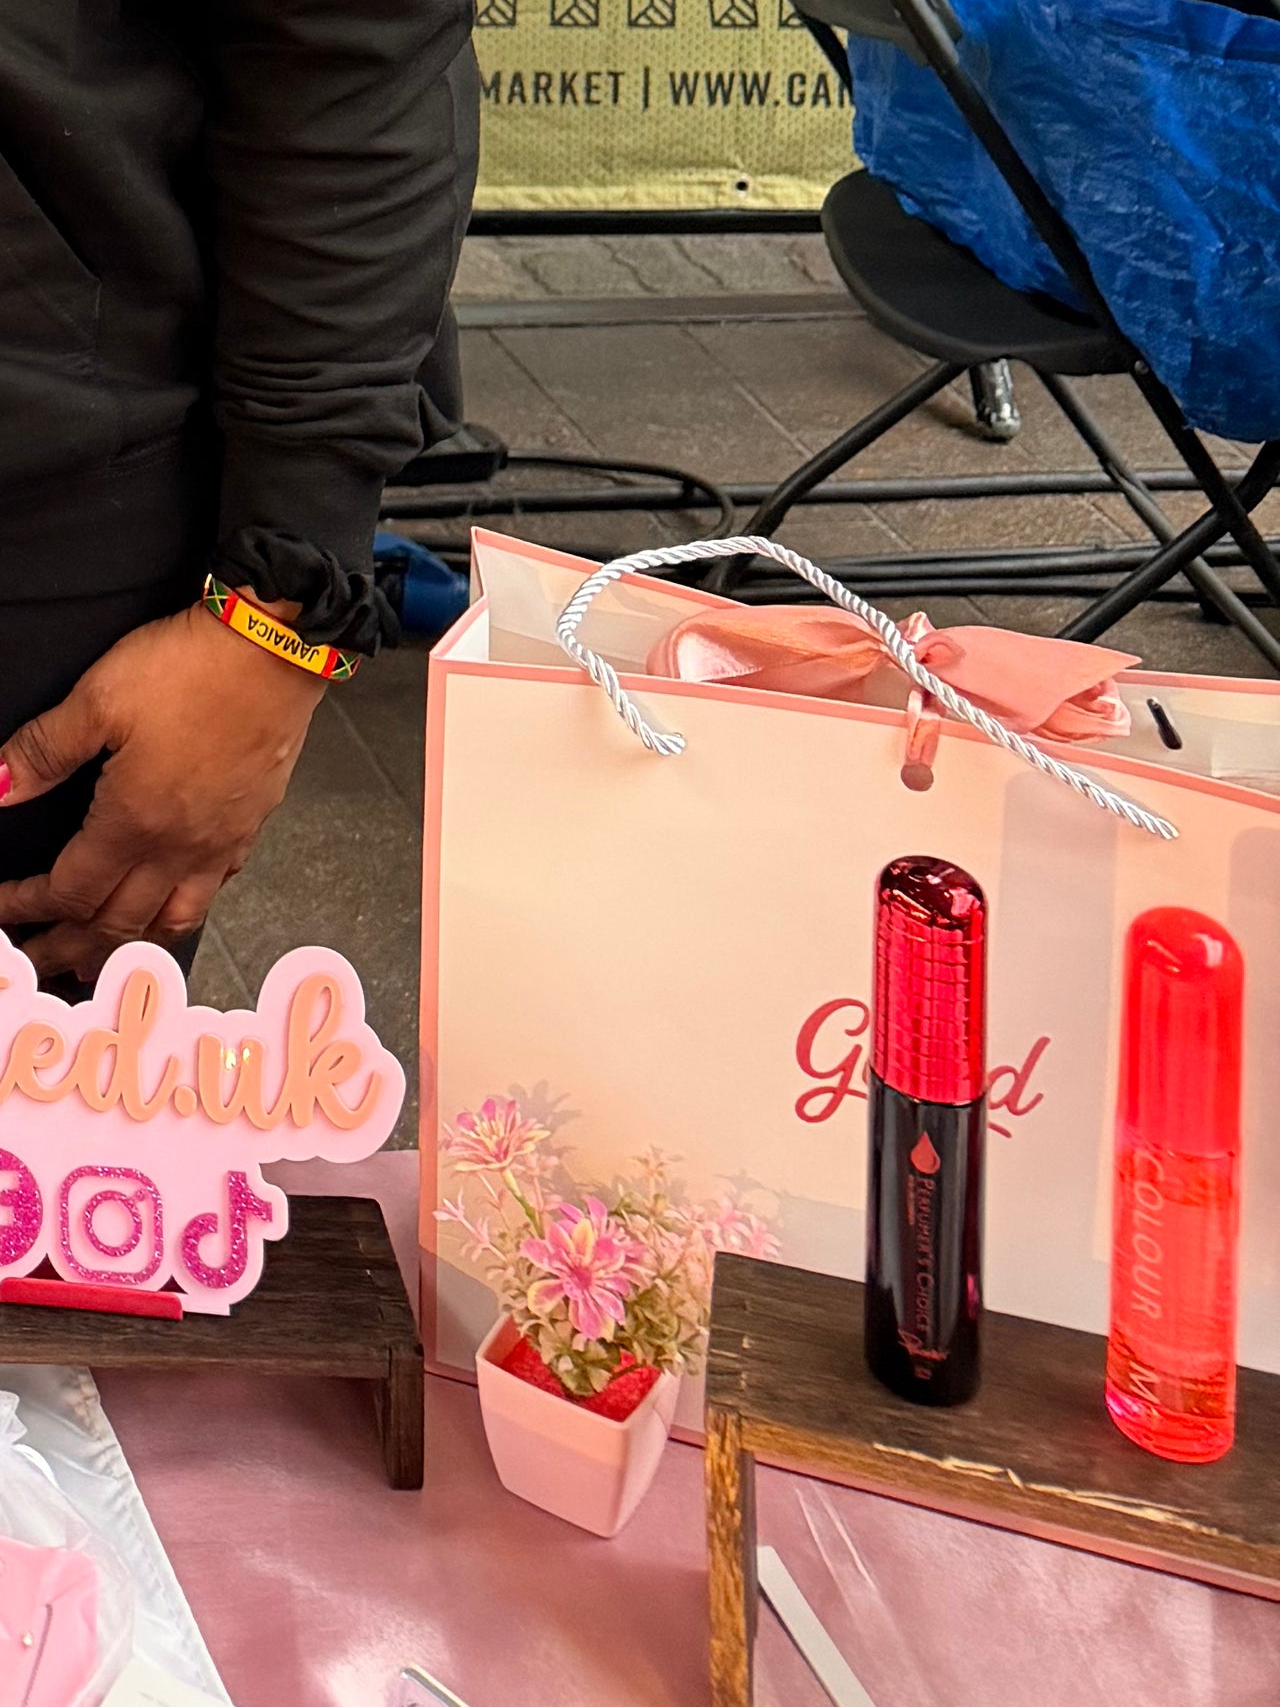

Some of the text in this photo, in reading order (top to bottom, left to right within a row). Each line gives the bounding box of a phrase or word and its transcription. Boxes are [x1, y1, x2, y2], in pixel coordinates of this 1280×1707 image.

[481, 71, 626, 106] MARKET
[247, 614, 320, 663] JAMAICA
[1132, 1149, 1164, 1320] COLOUR
